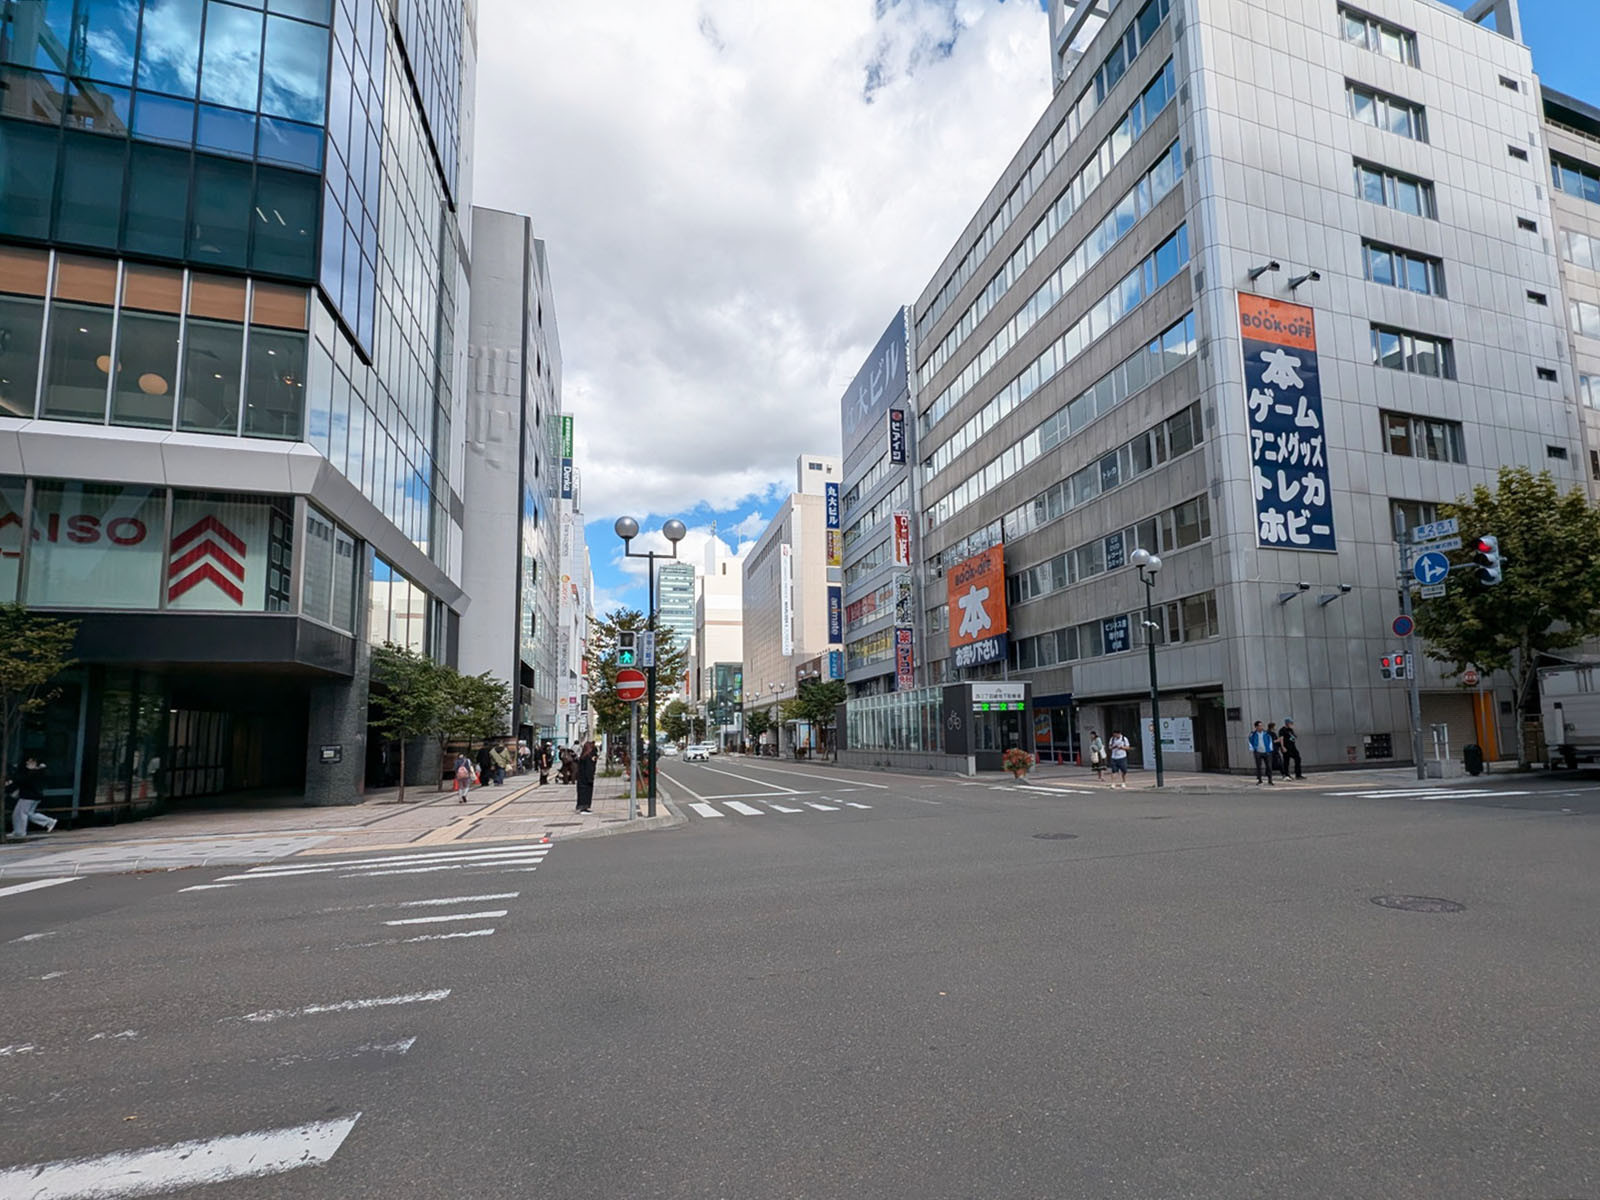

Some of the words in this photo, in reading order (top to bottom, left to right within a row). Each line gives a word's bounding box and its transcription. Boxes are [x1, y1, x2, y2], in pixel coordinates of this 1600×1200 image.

[1259, 348, 1304, 391] 本
[1248, 387, 1320, 430] ゲーム
[1250, 429, 1324, 468] アニメグッズ
[828, 486, 838, 525] 丸大ビル
[1253, 465, 1325, 507] トレカ
[1258, 507, 1331, 545] ホビー
[830, 597, 841, 636] animate
[958, 584, 991, 639] 本
[955, 639, 1000, 667] お売り下さい
